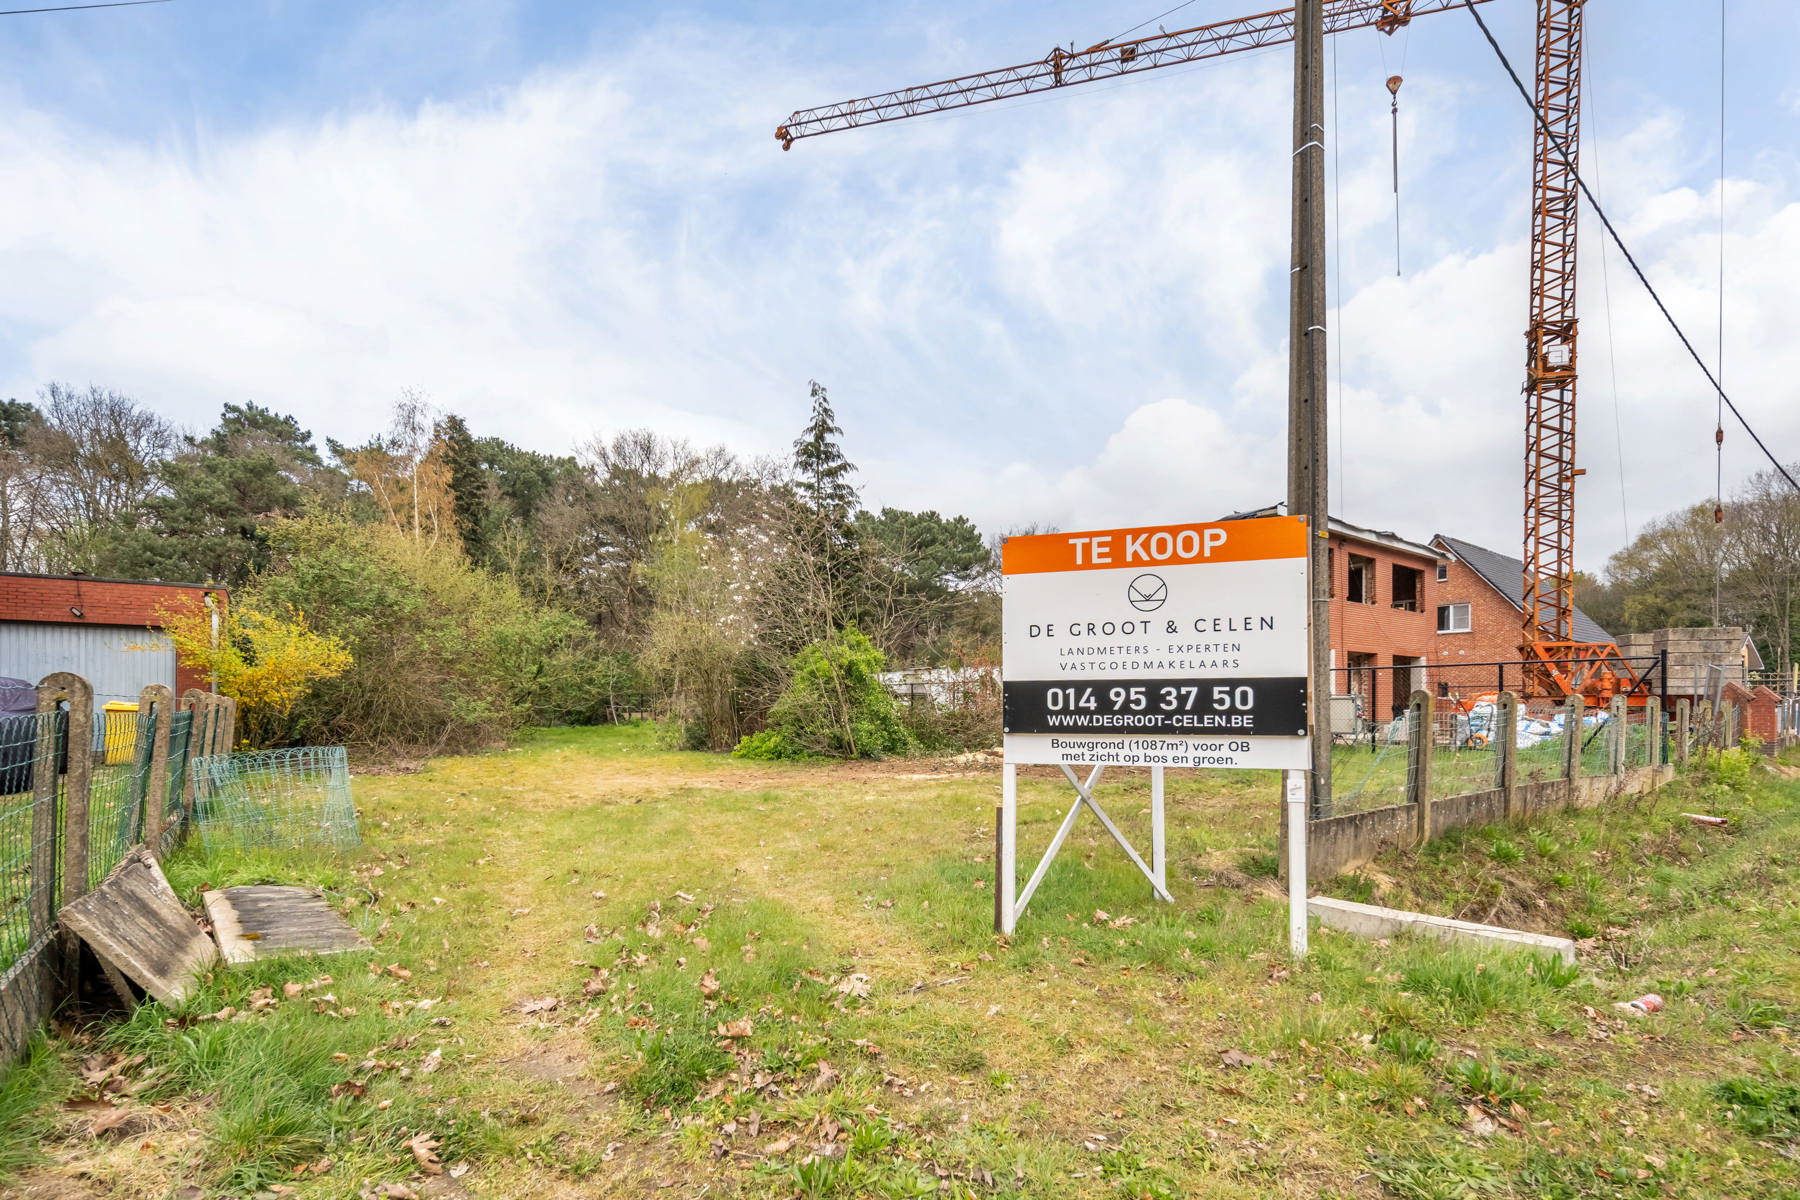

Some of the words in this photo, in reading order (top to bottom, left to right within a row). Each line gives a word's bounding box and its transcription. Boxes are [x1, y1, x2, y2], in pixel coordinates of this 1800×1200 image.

[1068, 536, 1112, 565] TE
[1125, 528, 1228, 562] KOOP
[1029, 624, 1055, 638] DE
[1069, 620, 1151, 636] GROOT
[1166, 620, 1178, 634] &
[1194, 616, 1274, 632] CELEN
[1060, 645, 1149, 656] LANDMETERS
[1168, 643, 1241, 654] EXPERTEN
[1060, 658, 1240, 671] VASTGOEDMAKELAARS
[1047, 687, 1097, 711] 014
[1109, 687, 1147, 710] 95
[1159, 686, 1198, 710] 37
[1212, 686, 1254, 711] 50
[1047, 715, 1254, 727] WWW.DEGROOT-CELEN.BE
[1051, 739, 1125, 752] Bouwgrond
[1128, 739, 1189, 753] (1087m²)
[1192, 743, 1224, 752] voor
[1228, 741, 1250, 752] OB
[1061, 752, 1086, 762] met
[1088, 751, 1120, 762] zicht
[1123, 754, 1140, 765] op
[1143, 752, 1168, 763] bos
[1173, 755, 1188, 764] en
[1192, 755, 1238, 767] groen.
